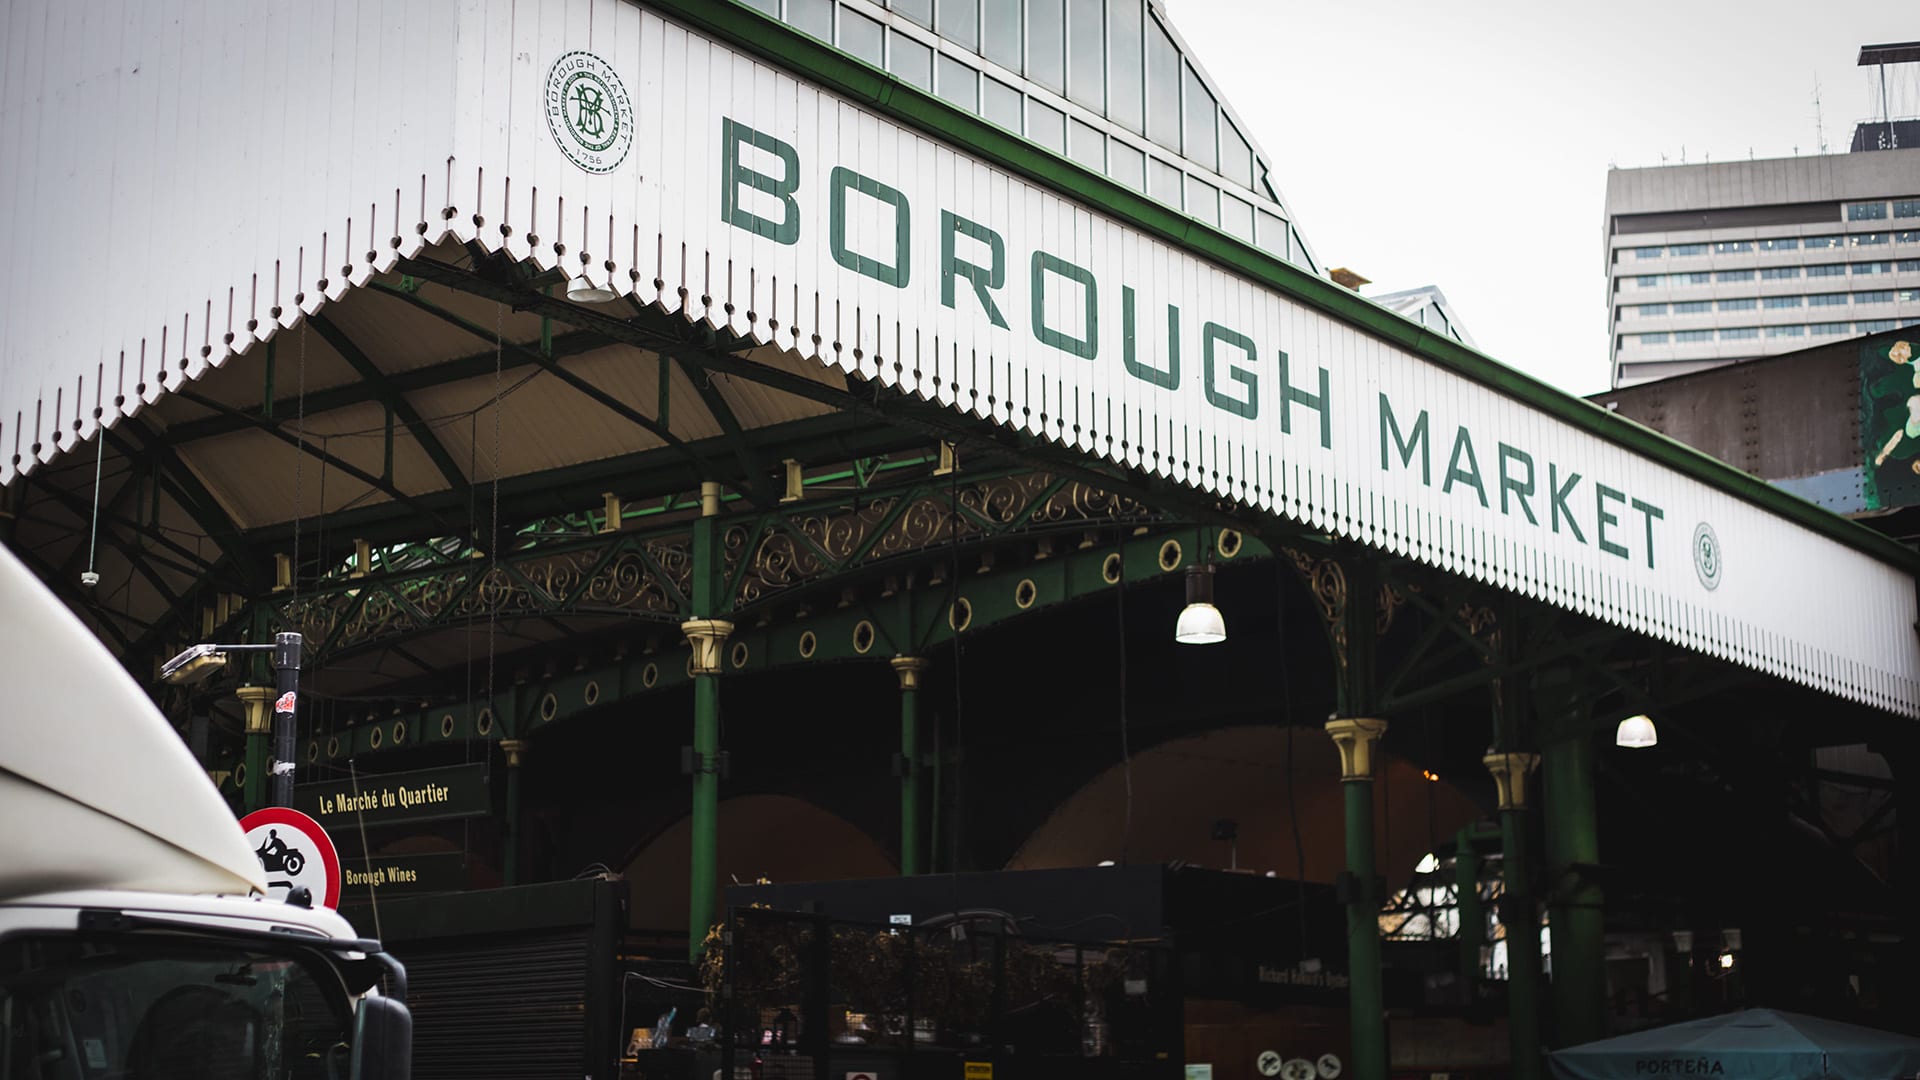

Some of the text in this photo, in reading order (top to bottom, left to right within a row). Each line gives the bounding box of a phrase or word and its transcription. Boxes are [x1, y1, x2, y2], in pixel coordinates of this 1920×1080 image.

[550, 58, 596, 117] BOROUGH
[601, 70, 629, 144] MARKET
[576, 148, 602, 165] 1756
[721, 116, 1664, 569] BOROUGH MARKET
[319, 783, 449, 815] Le Marché du Quartier
[346, 866, 417, 887] Borough Wines
[1636, 1057, 1725, 1075] PORTEÑA
